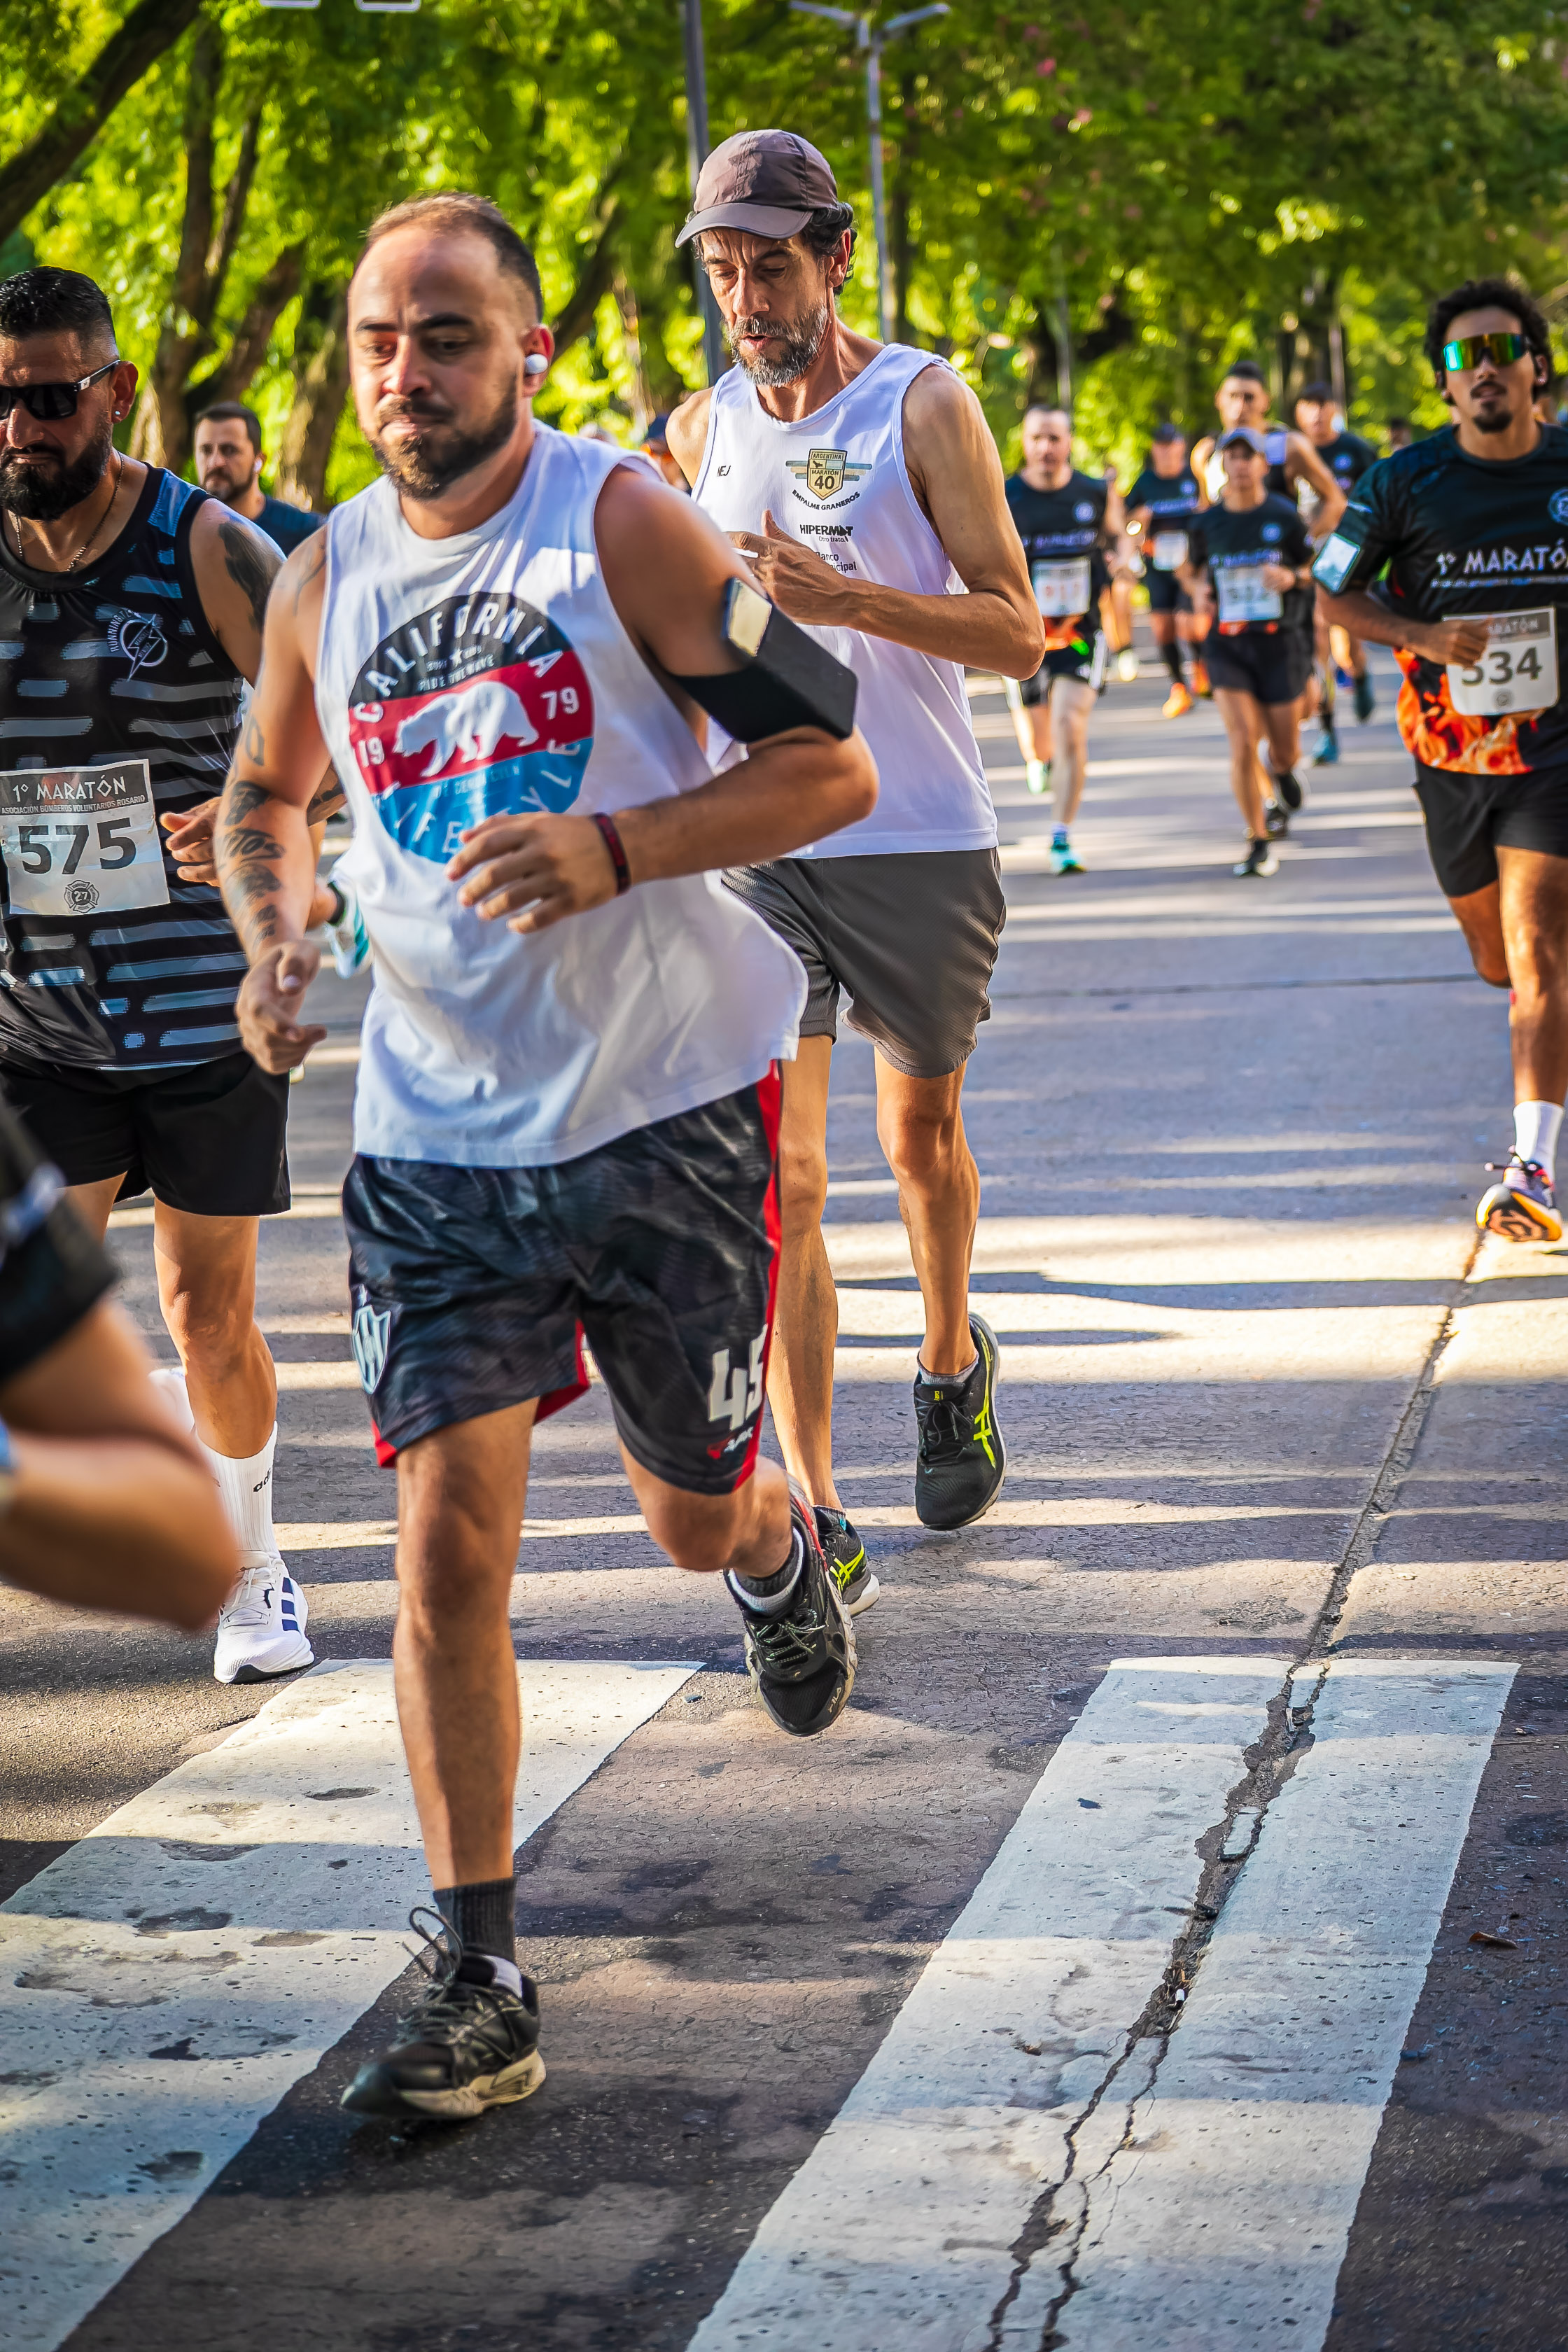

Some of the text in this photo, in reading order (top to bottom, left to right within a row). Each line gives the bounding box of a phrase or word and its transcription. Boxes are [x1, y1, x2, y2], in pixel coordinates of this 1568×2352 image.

[814, 475, 835, 490] 40
[792, 489, 860, 510] EMPALME GRANEROS
[353, 601, 564, 724] CALIFORNIA
[540, 687, 580, 720] 79
[357, 736, 385, 769] 19
[36, 774, 127, 801] MARATÓN
[72, 799, 115, 813] VOLUNTARIOS
[116, 794, 146, 806] ROSARIO
[18, 817, 137, 875] 575
[74, 890, 88, 902] 27
